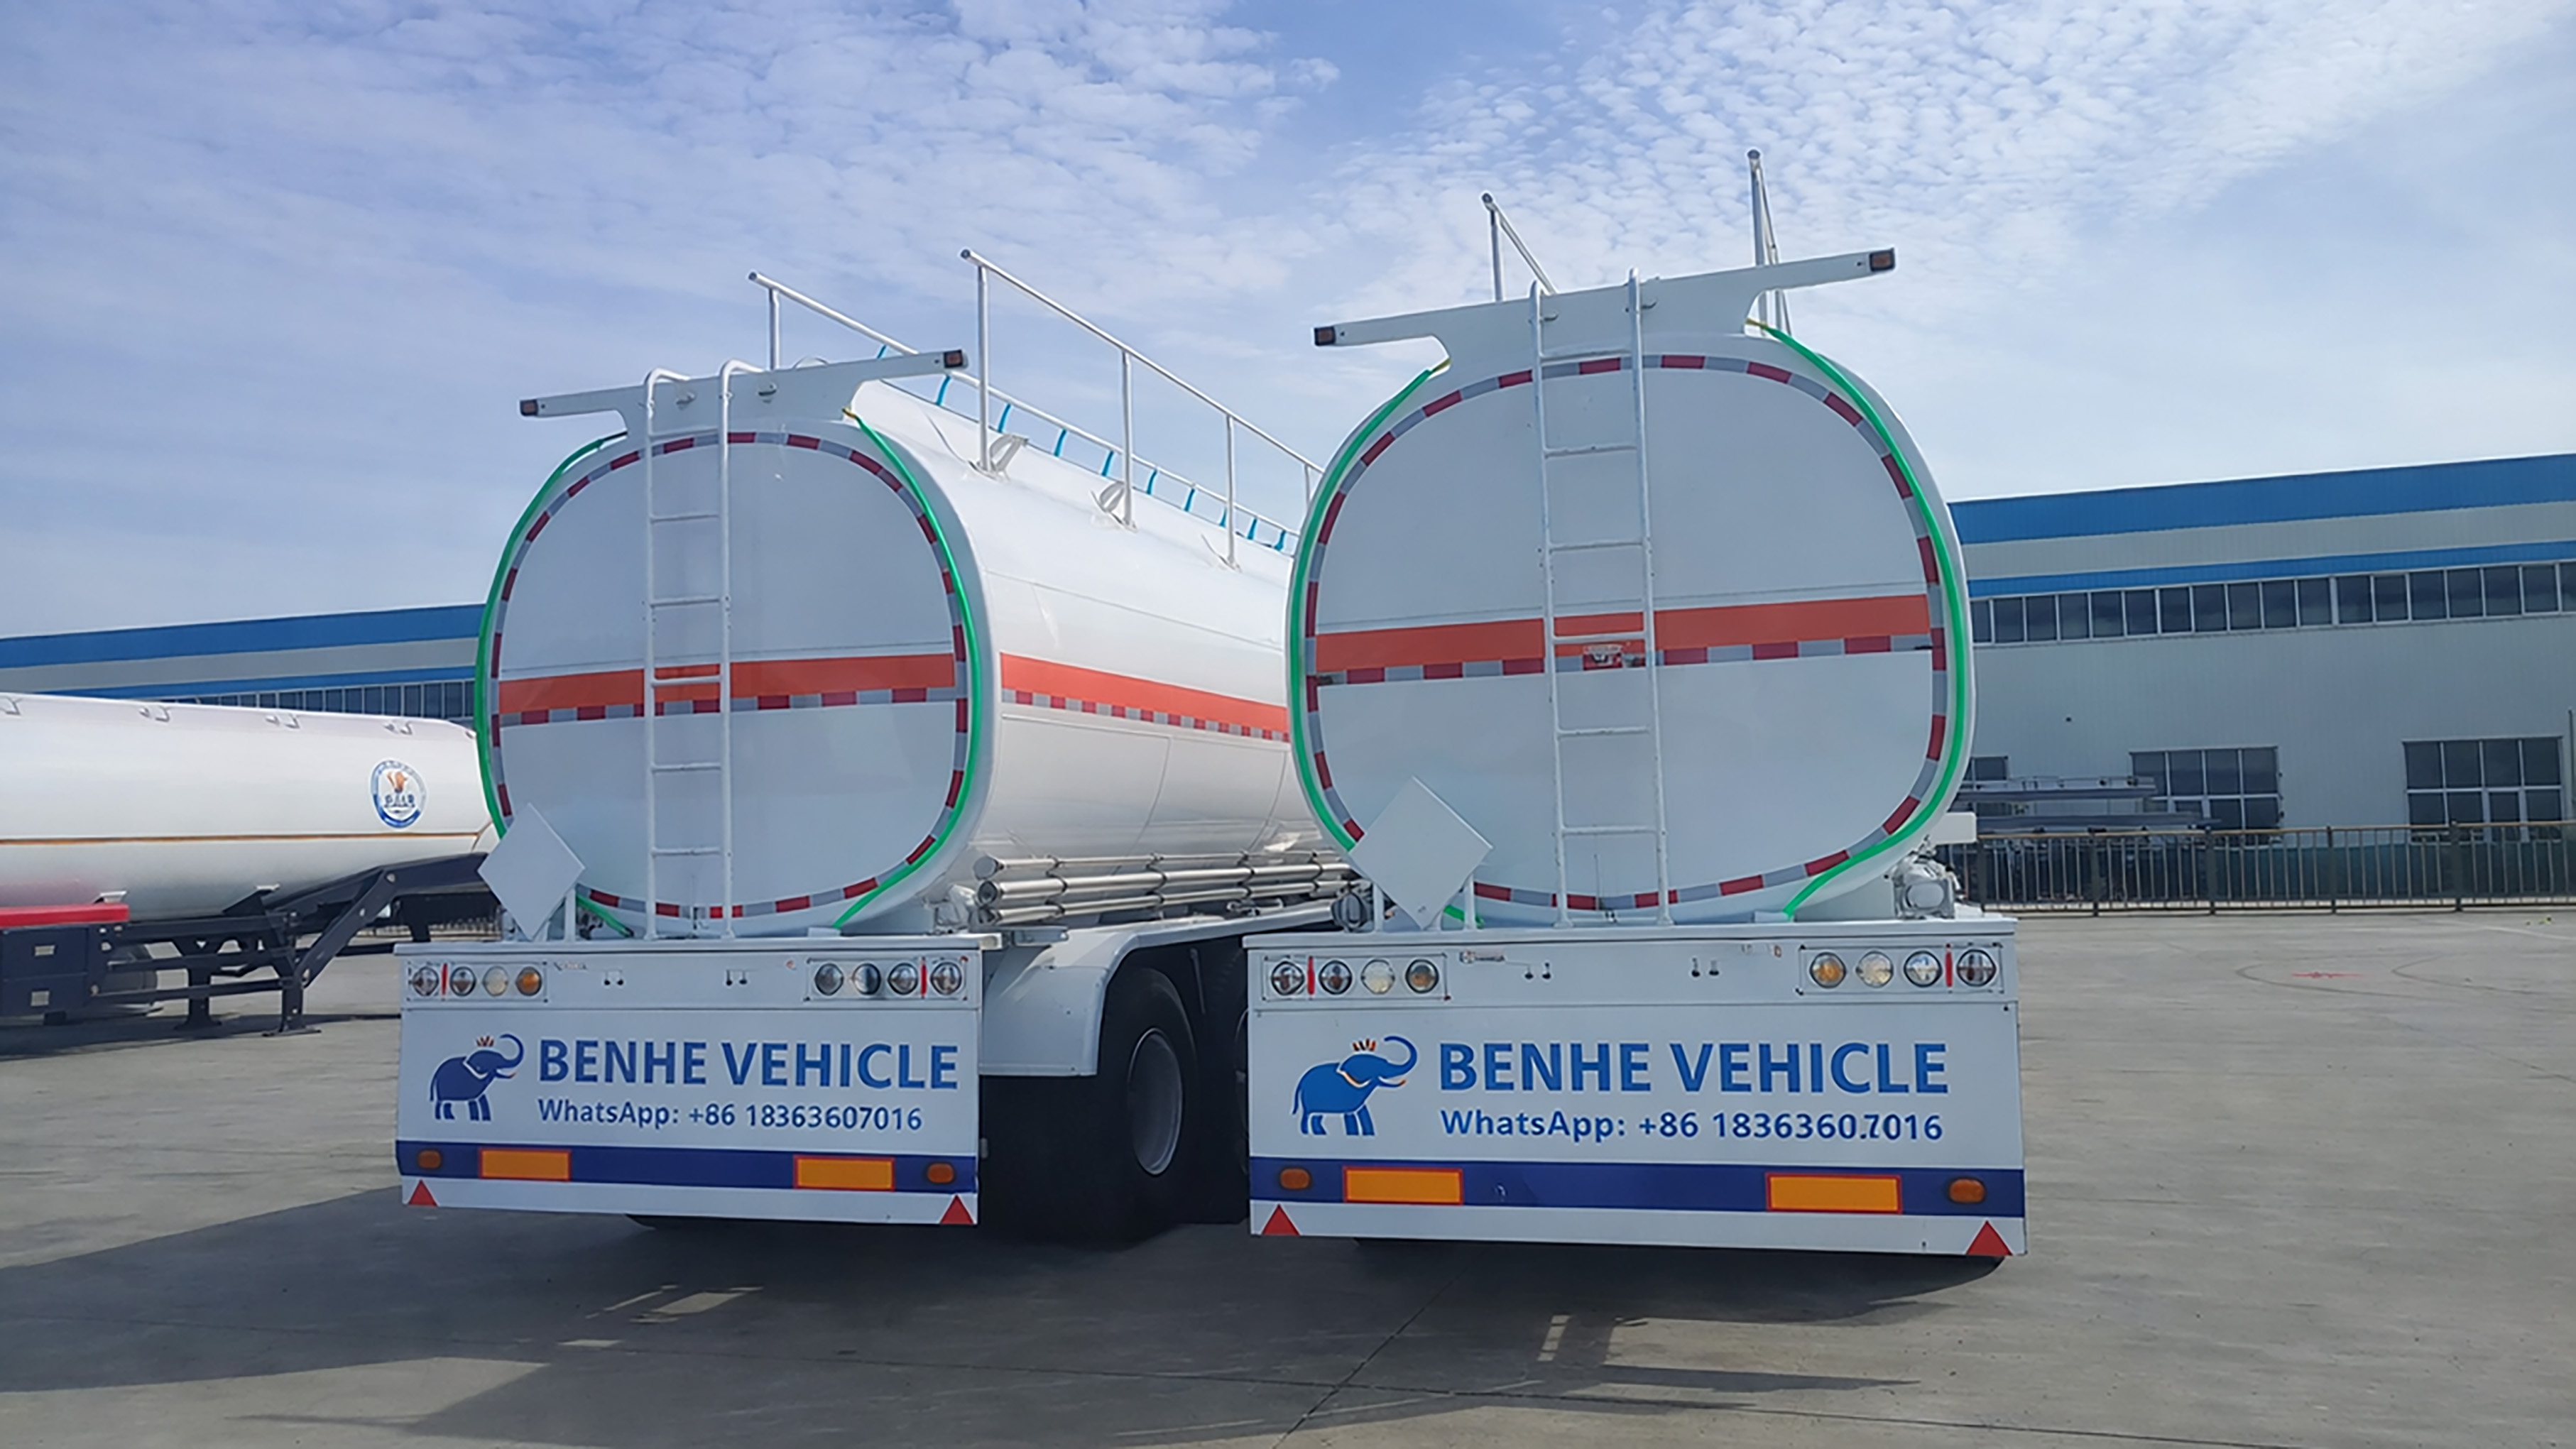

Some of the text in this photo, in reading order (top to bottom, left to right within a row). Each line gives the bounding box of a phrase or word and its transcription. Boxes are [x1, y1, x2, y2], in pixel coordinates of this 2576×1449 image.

[540, 1039, 958, 1090] BENHE VEHICLE
[1440, 1042, 1948, 1094] BENHE VEHICLE
[537, 1098, 922, 1131] WhatsApp: +86 18363607016
[1440, 1109, 1625, 1144] WhatsApp:
[1639, 1112, 1699, 1138] +86
